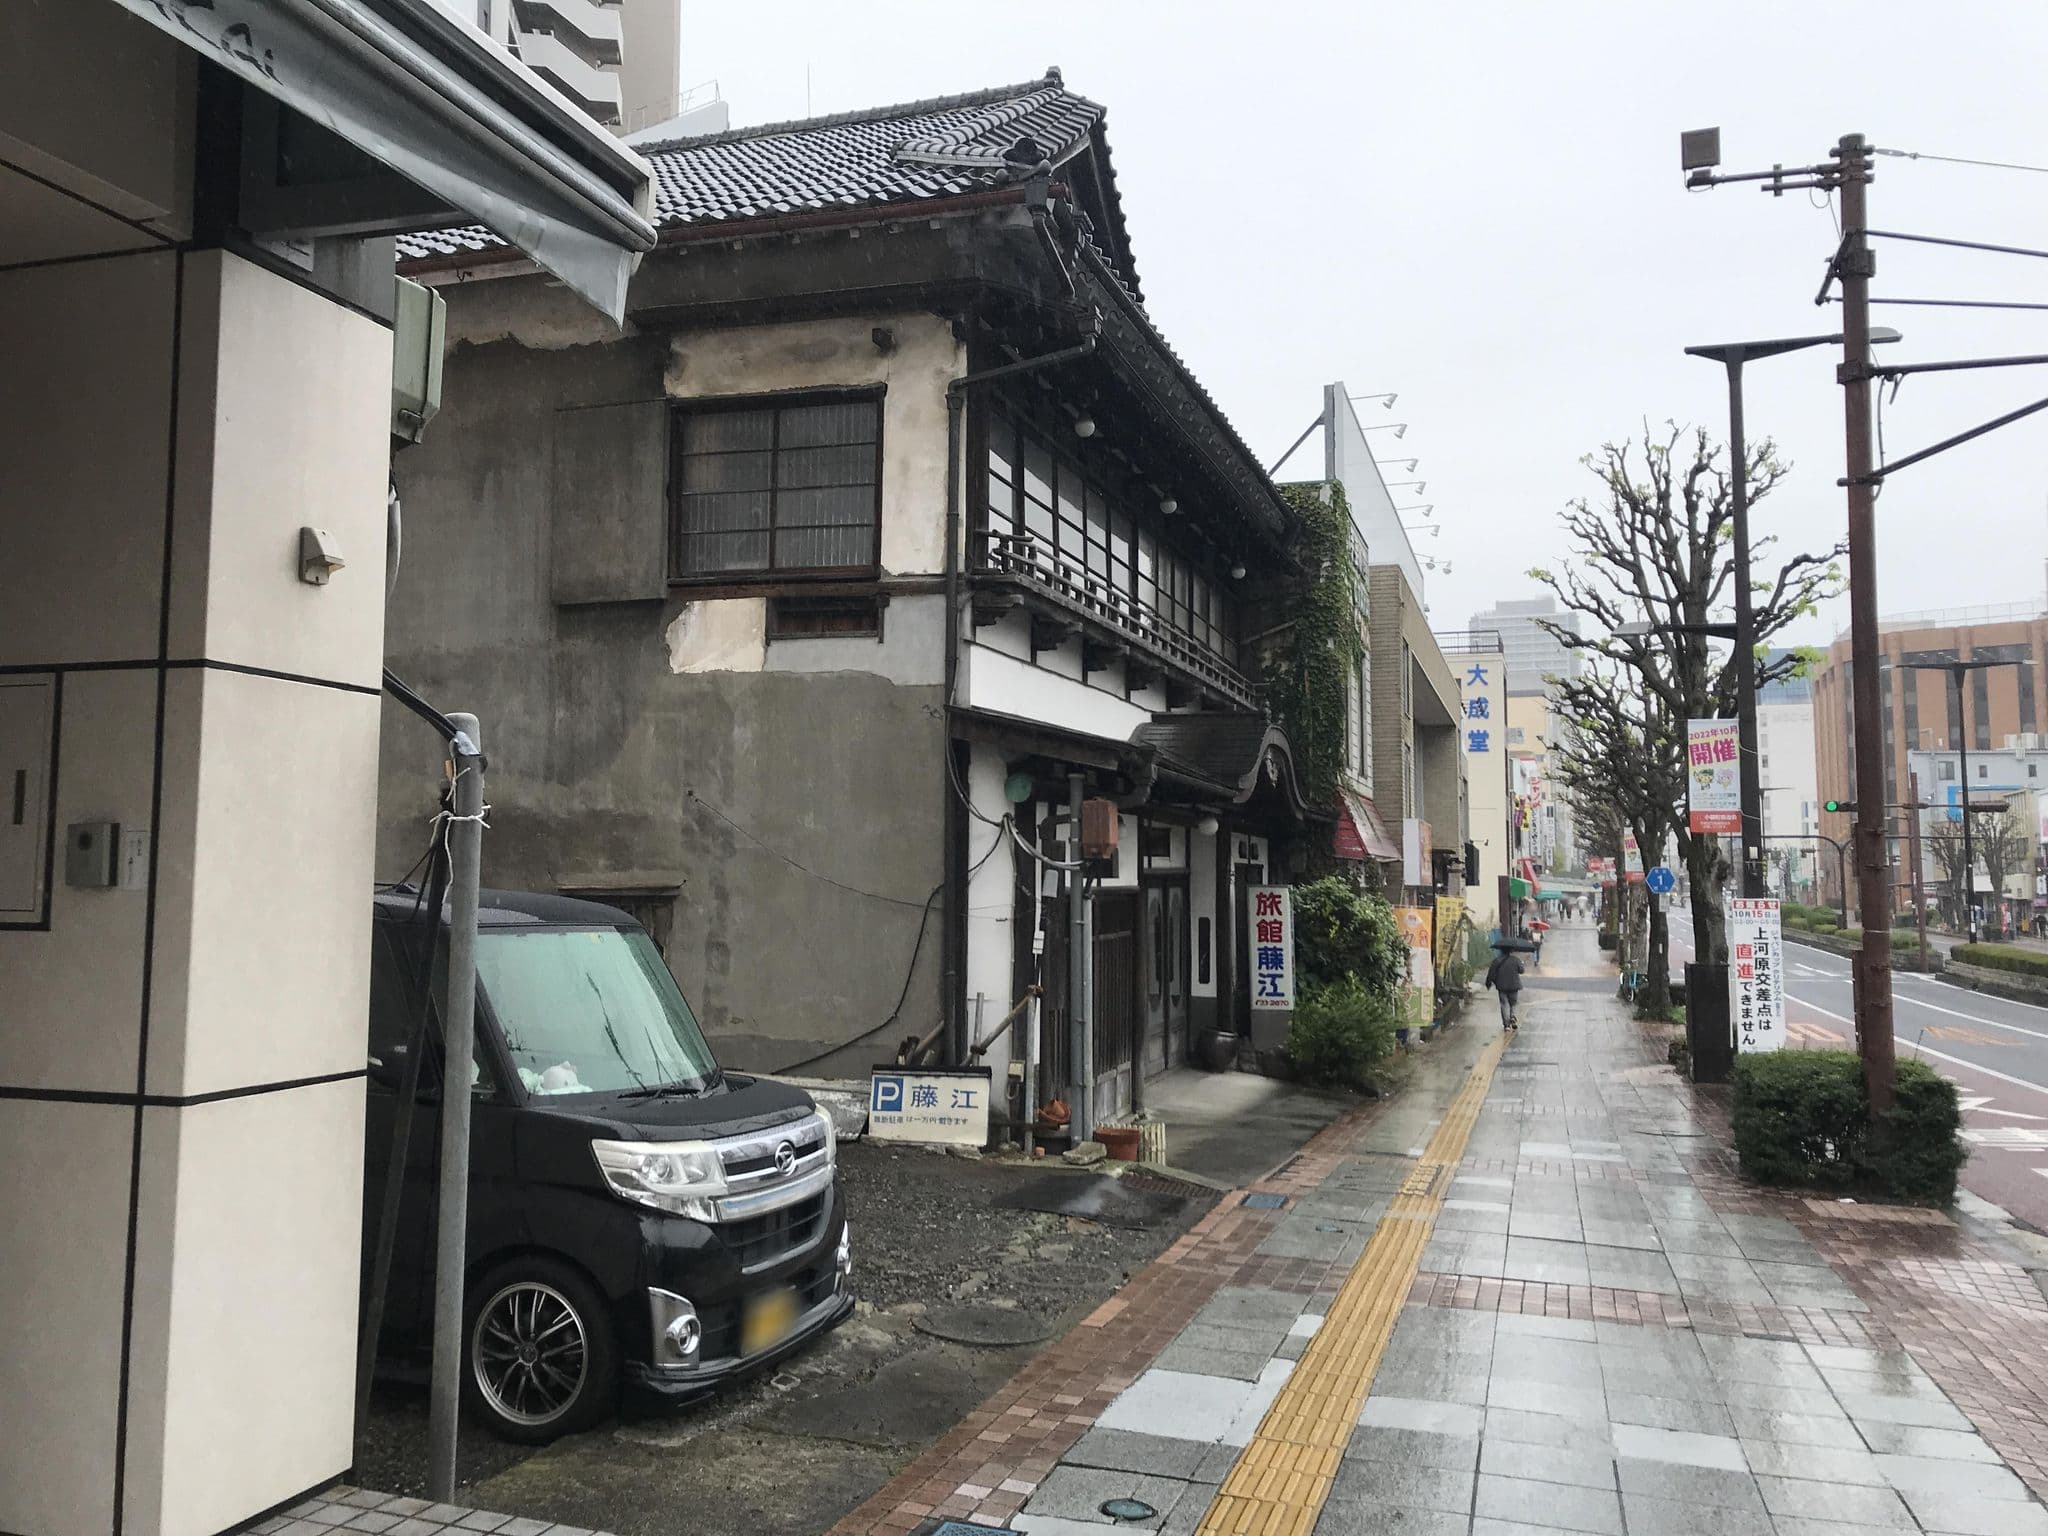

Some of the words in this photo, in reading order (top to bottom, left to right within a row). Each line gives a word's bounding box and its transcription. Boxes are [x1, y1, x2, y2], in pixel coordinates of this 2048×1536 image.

[1467, 664, 1489, 753] 大成堂
[1689, 725, 1738, 740] 2022年10月
[1689, 739, 1738, 766] 開催
[1657, 874, 1663, 886] 1
[1256, 892, 1285, 998] 旅館藤江
[1753, 927, 1772, 1031] 上河原交差点は
[911, 1084, 978, 1109] 藤江
